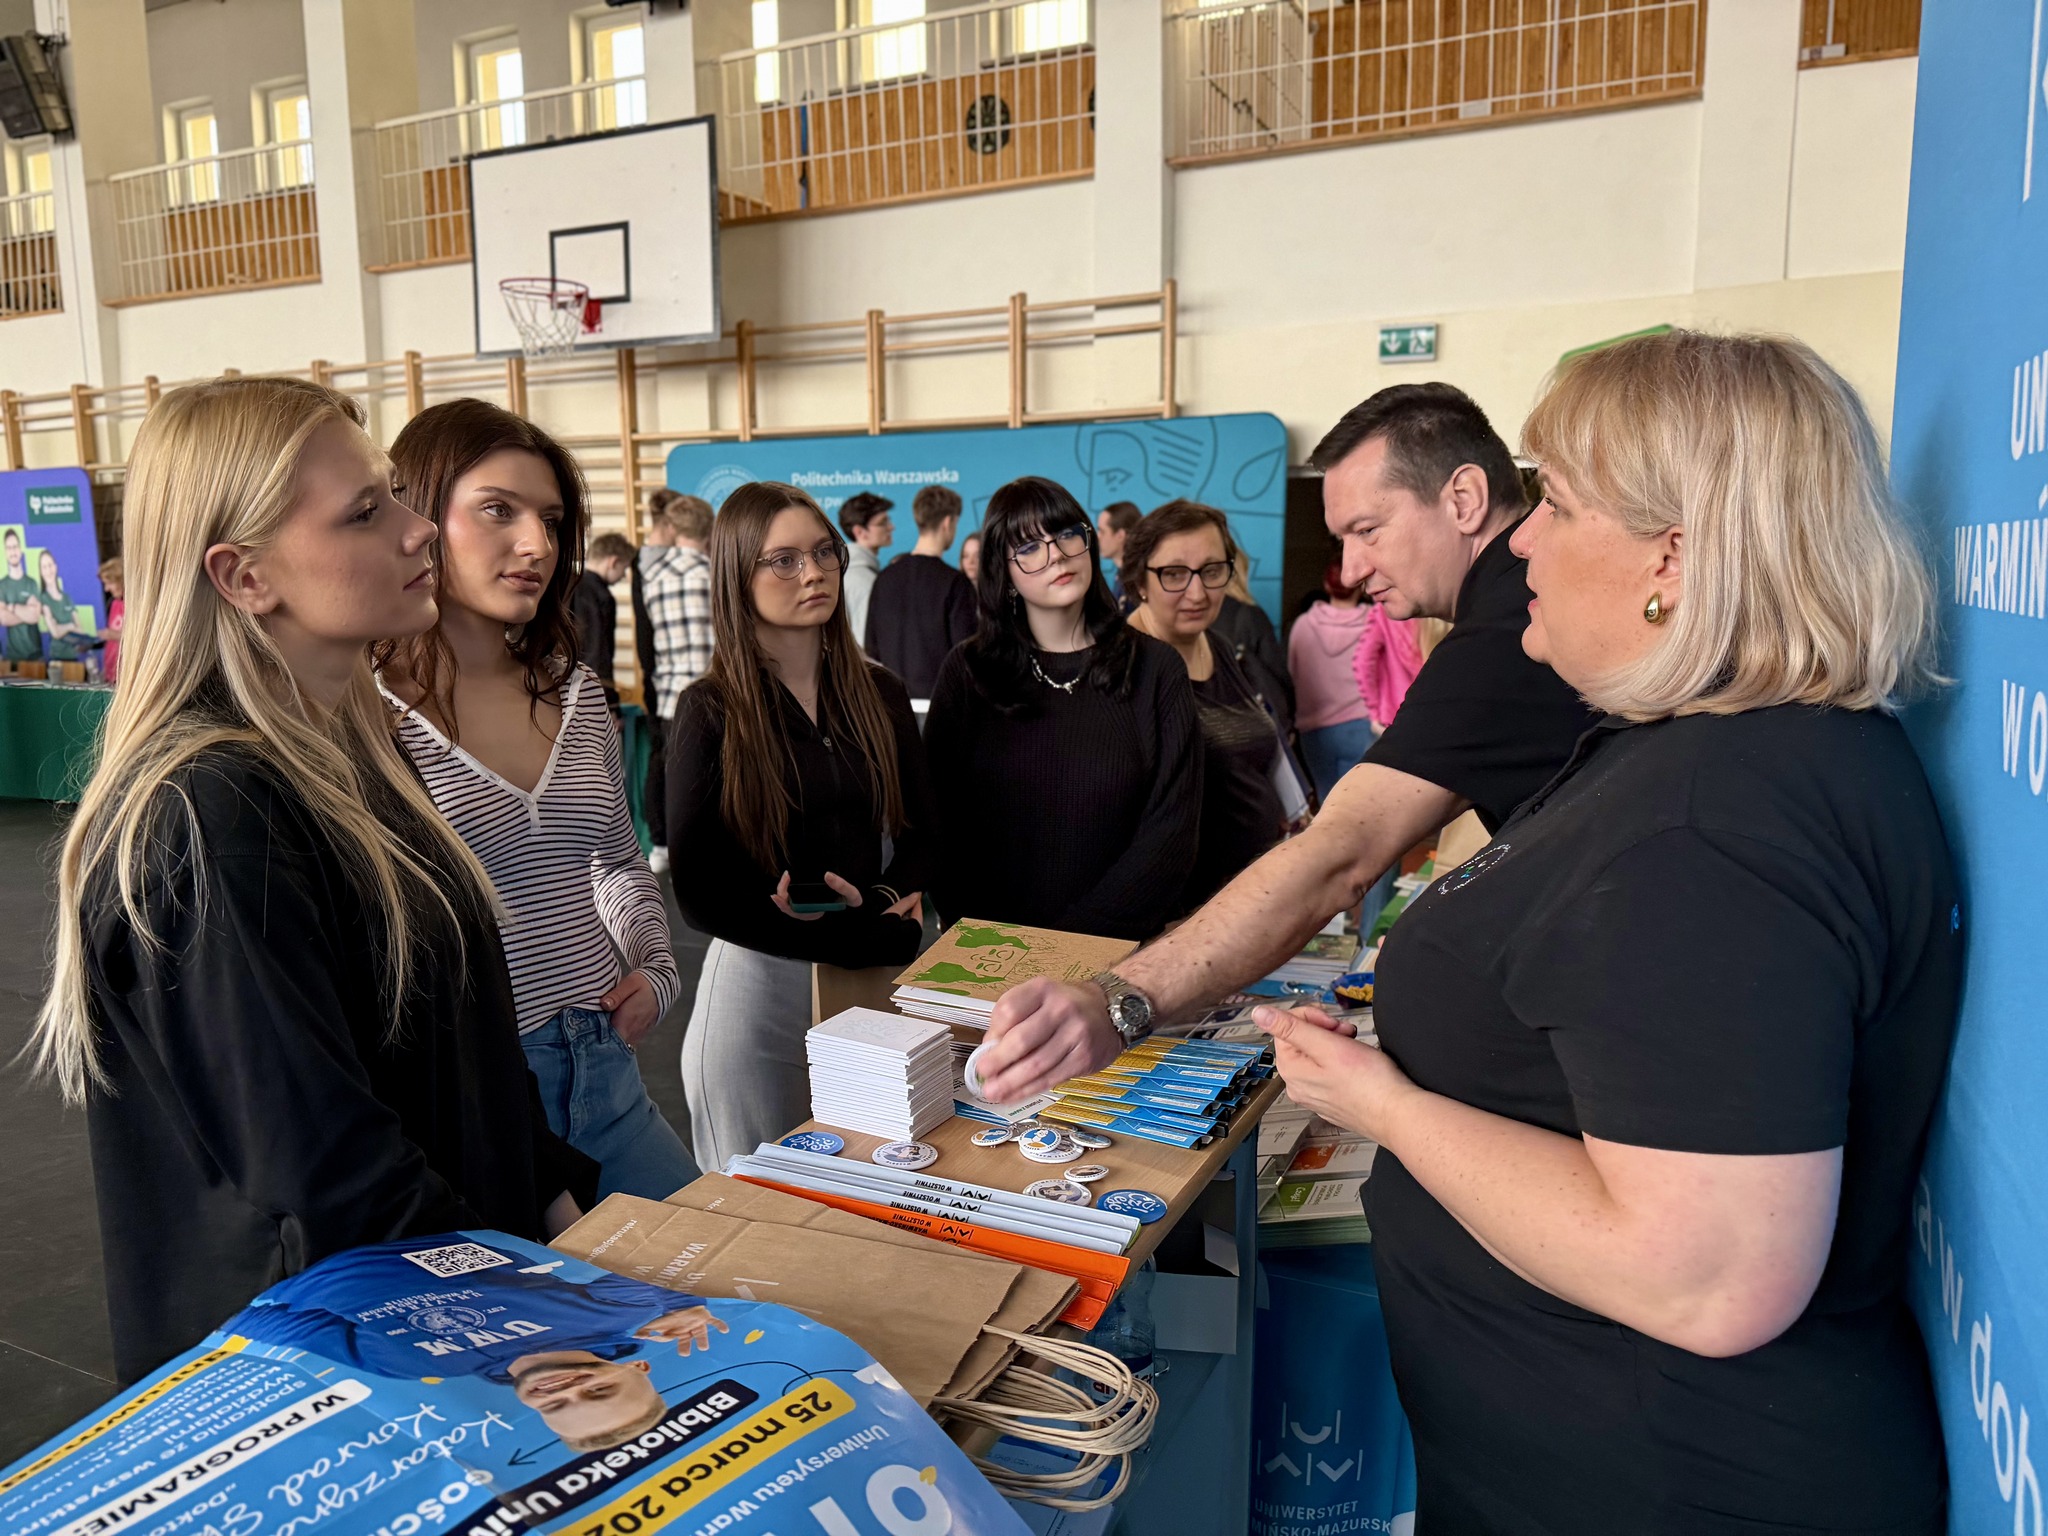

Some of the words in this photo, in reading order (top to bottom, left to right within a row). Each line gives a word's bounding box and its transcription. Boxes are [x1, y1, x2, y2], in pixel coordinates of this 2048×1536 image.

[791, 470, 872, 487] Politechnika
[875, 467, 959, 486] Warszawska
[903, 1190, 933, 1202] OLSZTYNIE
[915, 1180, 945, 1191] OLSZTYNIE
[890, 1201, 921, 1213] OLSZTYNIE
[893, 1214, 924, 1226] OLSZTYNIE
[1938, 1215, 1963, 1345] w
[413, 1320, 553, 1356] UWM
[196, 1365, 281, 1412] kultura
[312, 1394, 347, 1413] W
[191, 1380, 307, 1443] spotkania
[784, 1391, 832, 1423] 25
[116, 1418, 182, 1456] sport
[159, 1442, 188, 1460] ze
[268, 1403, 446, 1506] Konrad
[556, 1391, 740, 1496] Biblioteka
[73, 1412, 307, 1536] PROGRAMIE:
[659, 1417, 787, 1498] marca
[753, 1424, 890, 1502] Uniwersytetu
[1255, 1499, 1358, 1520] UNIWERSYTET
